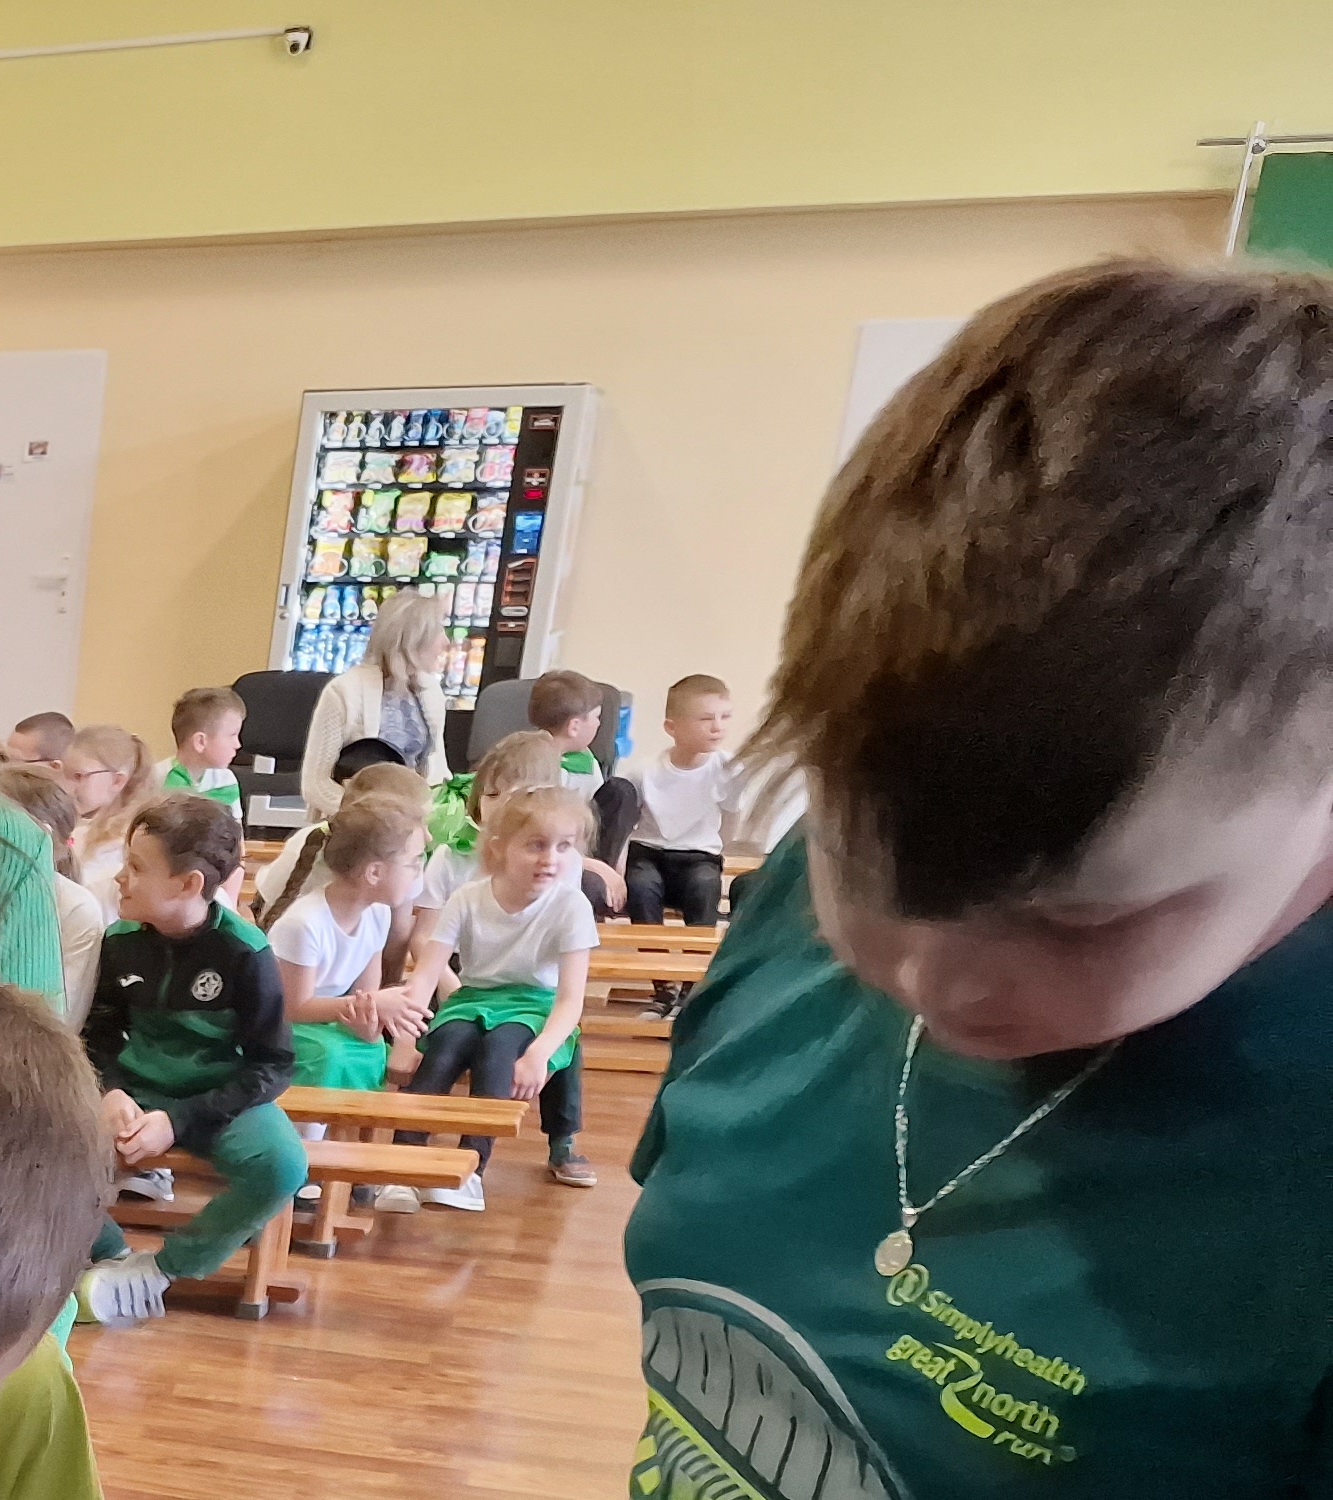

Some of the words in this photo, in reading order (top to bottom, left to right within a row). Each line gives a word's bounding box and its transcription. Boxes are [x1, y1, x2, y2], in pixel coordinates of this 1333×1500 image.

[886, 1334, 957, 1385] great
[919, 1290, 1085, 1395] Simplyhealth
[972, 1382, 1059, 1438] north
[993, 1431, 1053, 1465] run
